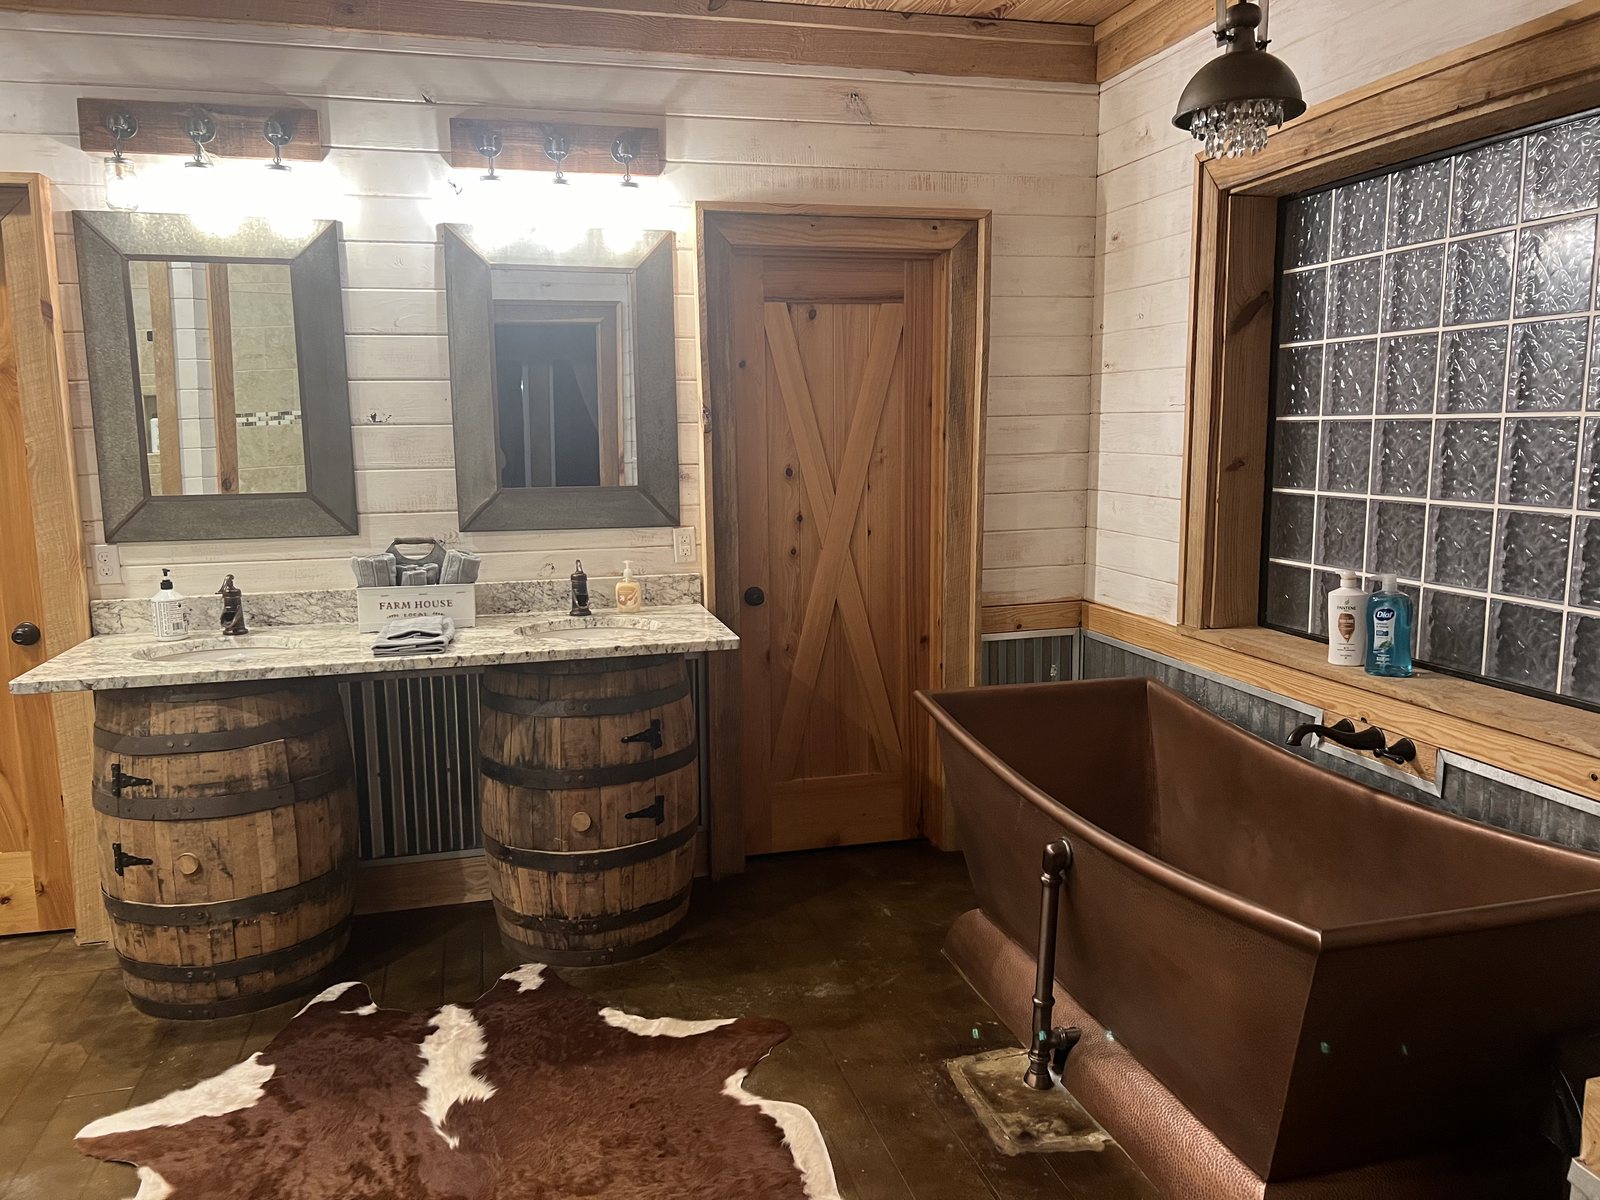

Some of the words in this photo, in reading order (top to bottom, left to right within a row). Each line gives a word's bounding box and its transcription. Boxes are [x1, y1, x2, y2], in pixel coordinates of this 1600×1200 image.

[379, 601, 411, 610] FARM
[415, 599, 454, 609] HOUSE
[1376, 611, 1394, 619] Dial
